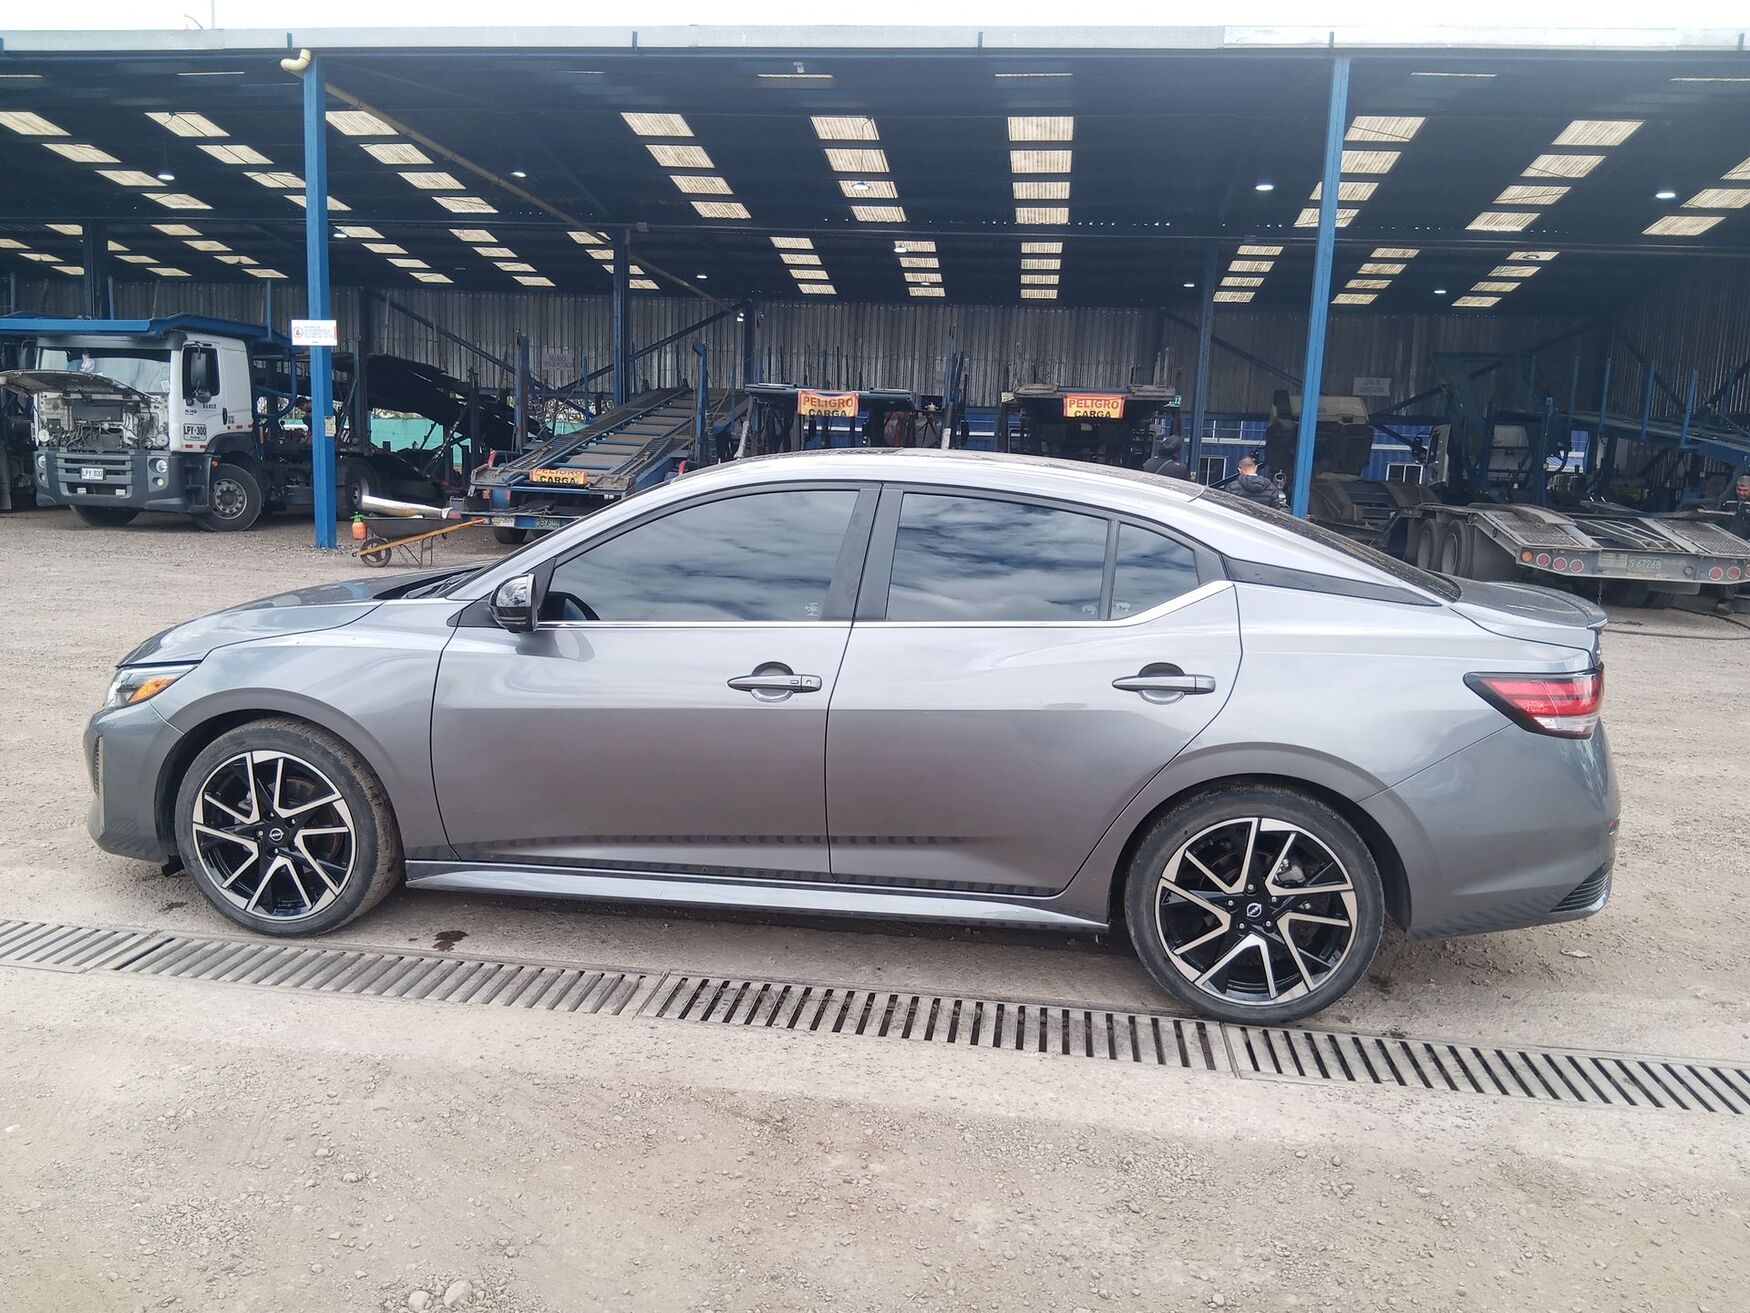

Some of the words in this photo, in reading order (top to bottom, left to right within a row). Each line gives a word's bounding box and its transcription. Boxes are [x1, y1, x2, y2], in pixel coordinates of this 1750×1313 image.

[803, 396, 853, 408] PELIGRO
[1069, 400, 1119, 409] PELIGRO
[809, 409, 847, 417] CARGA
[1074, 410, 1111, 418] CARGA
[540, 475, 576, 484] CARGA
